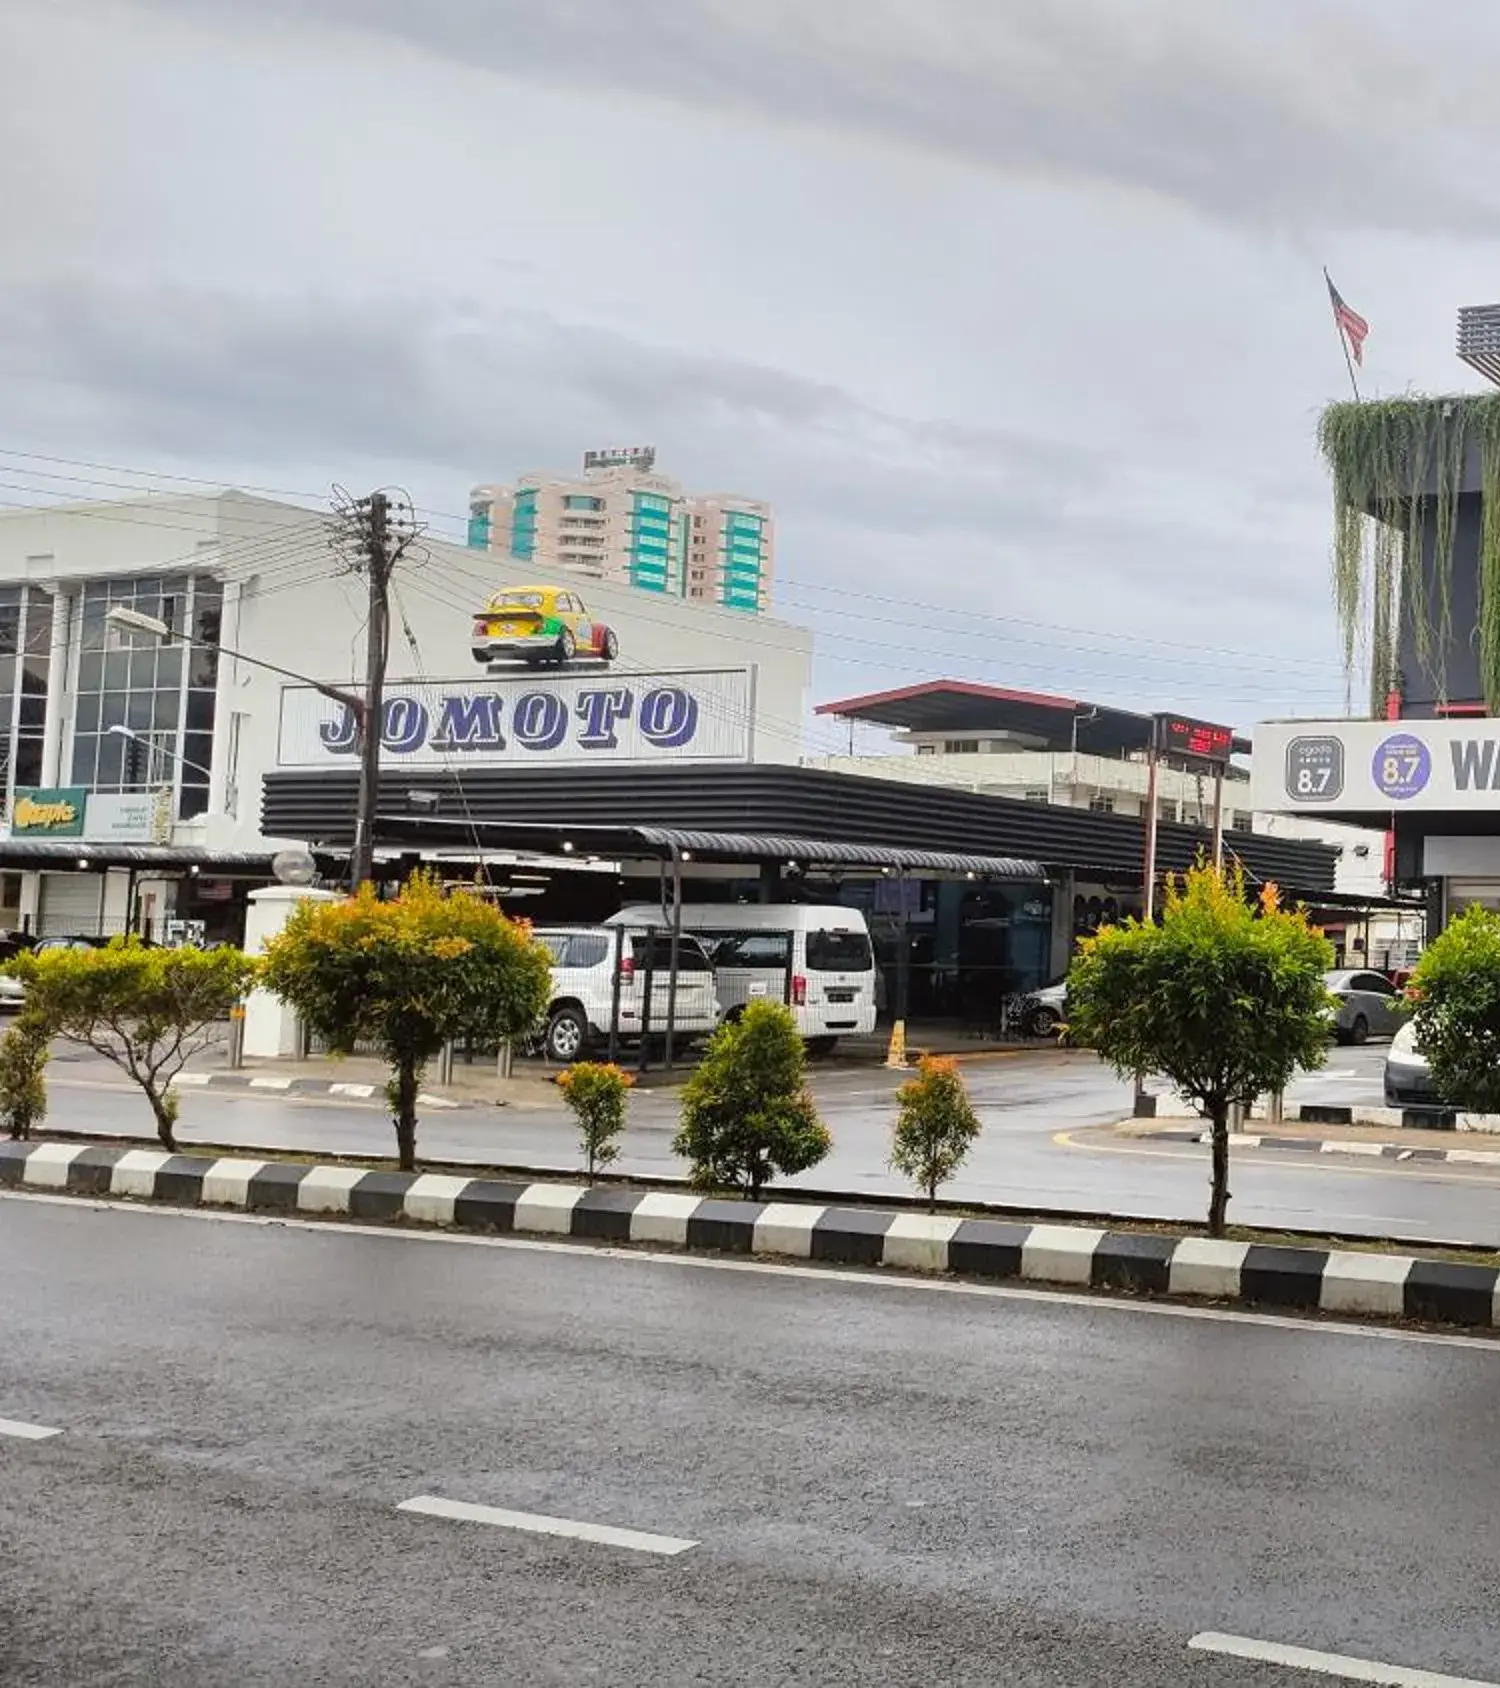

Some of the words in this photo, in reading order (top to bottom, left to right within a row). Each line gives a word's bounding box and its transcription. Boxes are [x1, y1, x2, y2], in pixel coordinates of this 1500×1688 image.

[320, 687, 698, 755] JOMOTO
[1298, 768, 1331, 793] 8.7
[1383, 757, 1420, 784] 8.7
